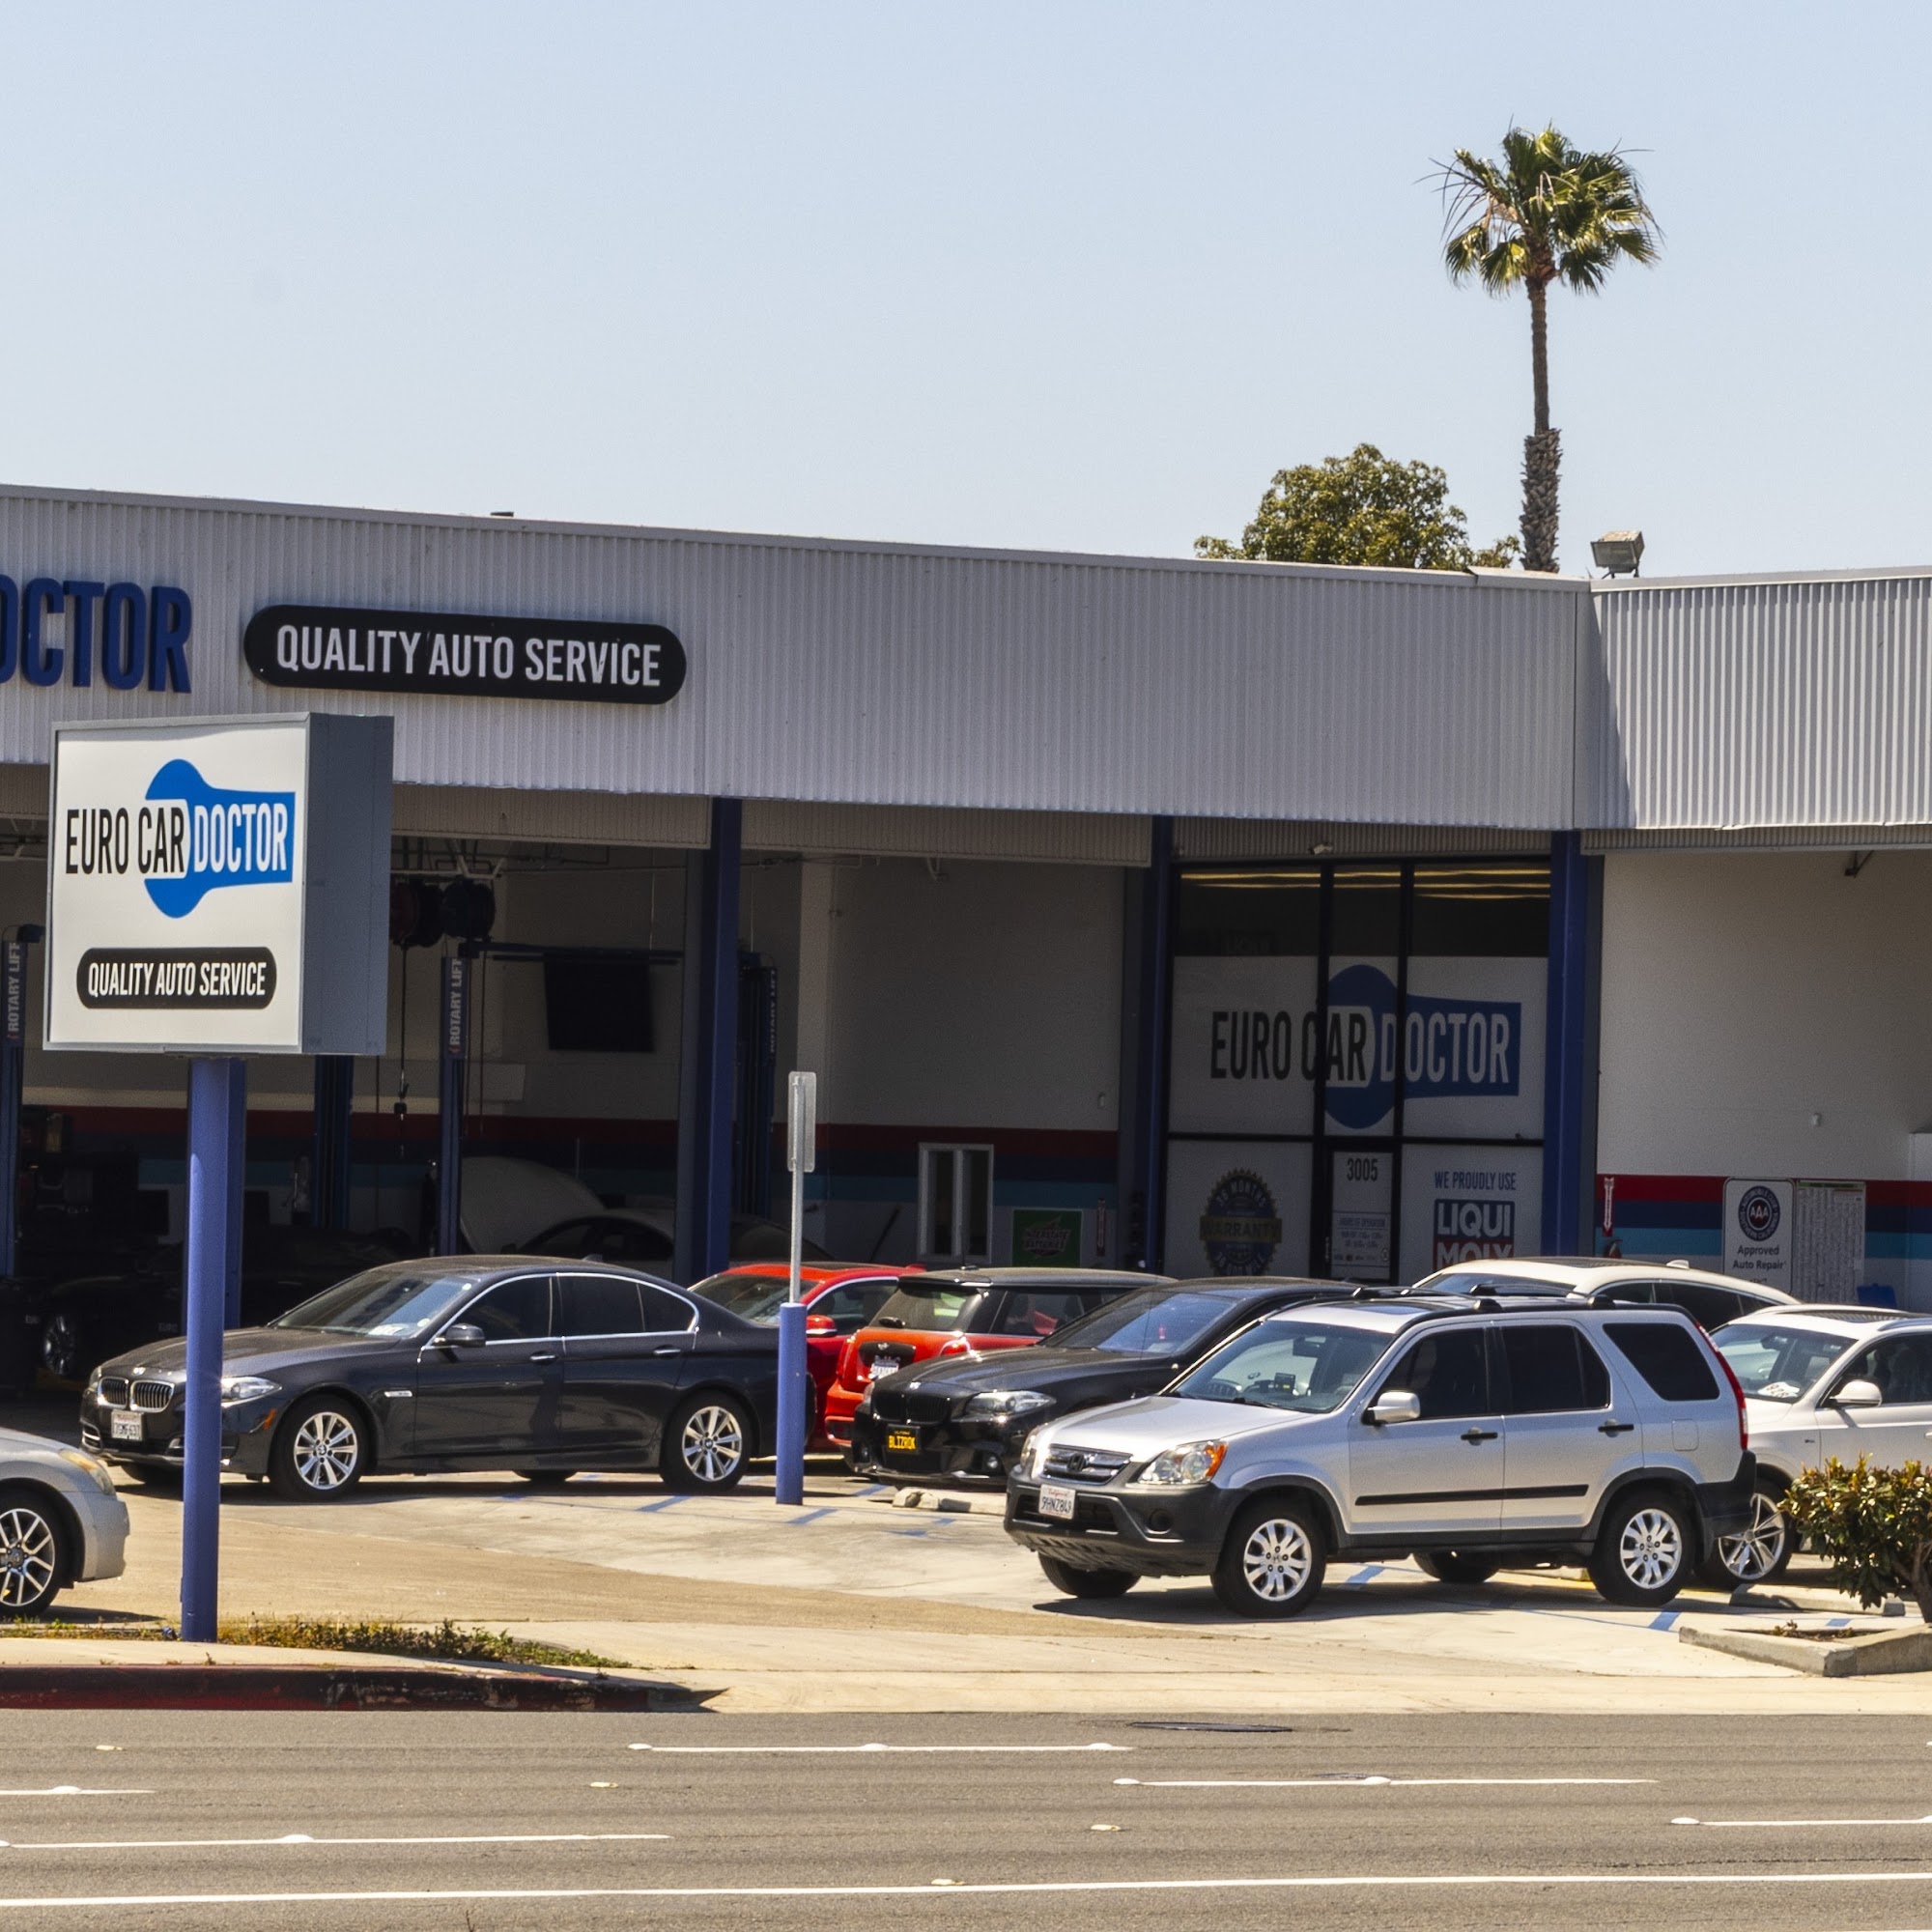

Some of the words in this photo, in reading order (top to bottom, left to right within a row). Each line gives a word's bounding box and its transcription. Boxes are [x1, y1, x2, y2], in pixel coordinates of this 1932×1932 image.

[277, 625, 421, 673] QUALITY
[429, 634, 514, 679] AUTO
[525, 639, 662, 687] SERVICE
[66, 808, 129, 874] EURO
[138, 807, 185, 874] CAR
[194, 803, 288, 873] DOCTOR
[9, 943, 19, 972] LIFT
[88, 962, 155, 997] QUALITY
[155, 962, 196, 996] AUTO
[199, 961, 267, 996] SERVICE
[451, 959, 463, 987] LIFT
[8, 977, 19, 1032] ROTARY
[449, 992, 462, 1045] ROTARY
[1210, 1010, 1292, 1081] EURO
[1301, 1010, 1367, 1081] CAR
[1380, 1011, 1510, 1084] DOCTOR
[1347, 1158, 1378, 1181] 3005
[1435, 1171, 1449, 1189] WE
[1452, 1171, 1496, 1190] PROUDLY
[1498, 1172, 1517, 1191] USE
[1436, 1203, 1511, 1238] LIQUI
[1749, 1205, 1769, 1219] AAA
[1203, 1222, 1278, 1238] WARRANTY
[1732, 1260, 1754, 1269] Auto
[1737, 1244, 1779, 1258] Approved
